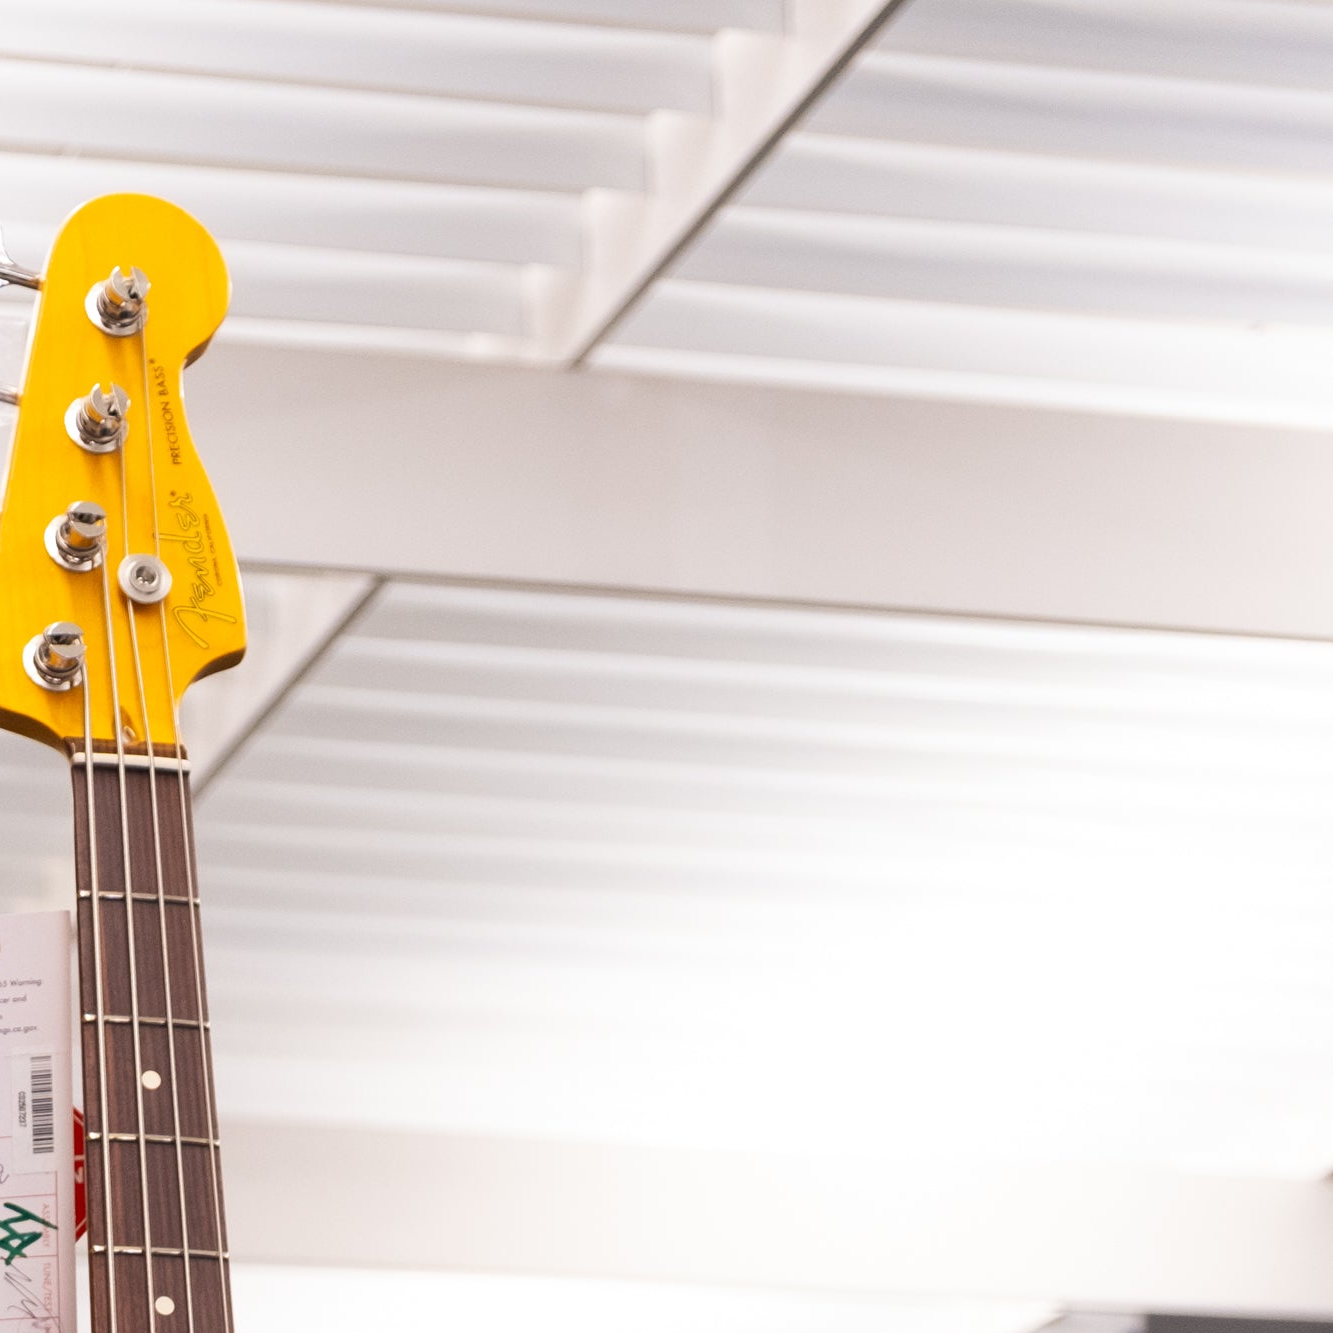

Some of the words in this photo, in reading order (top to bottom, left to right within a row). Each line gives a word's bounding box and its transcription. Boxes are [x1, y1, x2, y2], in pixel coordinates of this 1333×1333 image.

[161, 401, 182, 466] PRECISION
[153, 492, 237, 650] Fender
[12, 994, 27, 1002] and
